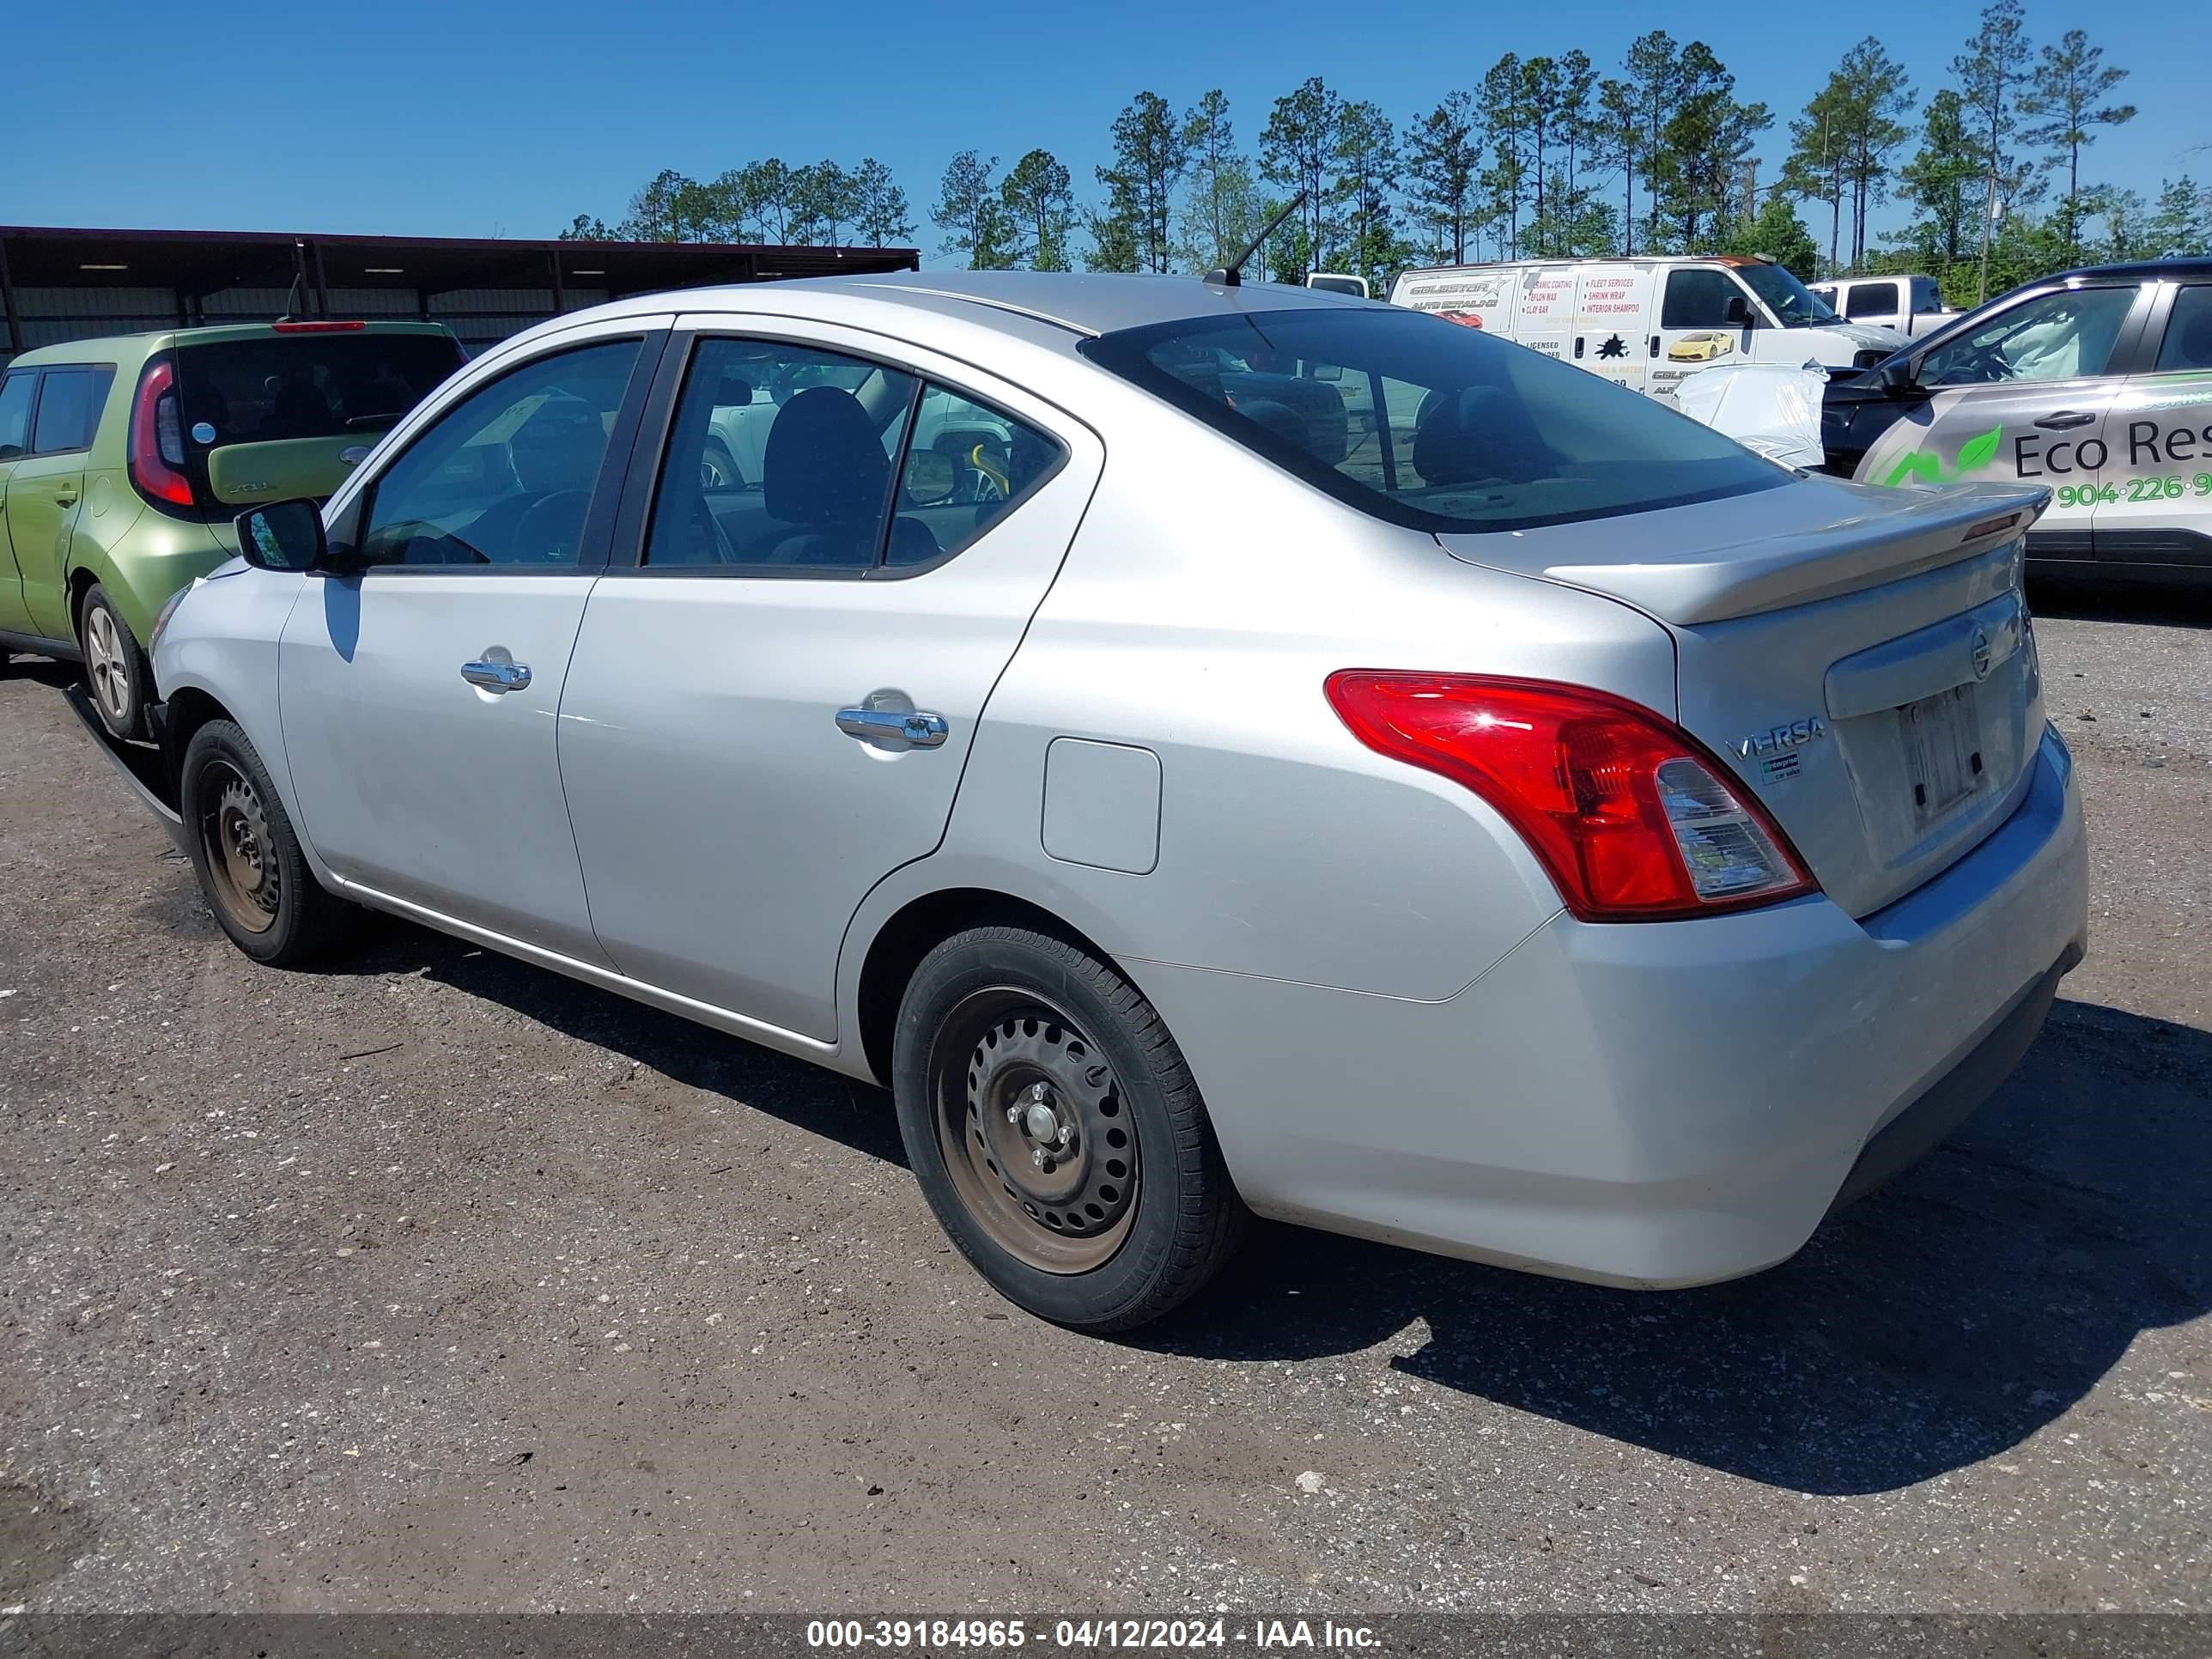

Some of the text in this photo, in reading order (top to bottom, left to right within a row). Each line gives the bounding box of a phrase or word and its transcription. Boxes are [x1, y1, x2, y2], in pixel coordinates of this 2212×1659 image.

[1532, 280, 1572, 289] ERAMIC COATING
[1589, 278, 1634, 289] FLEET SERVICES
[1410, 283, 1489, 295] GOLDSTAR
[1528, 293, 1558, 302] TEFLON WAX
[1588, 291, 1626, 301] SHRINK WRAP
[1411, 301, 1441, 310] AUTO
[1526, 305, 1549, 314] CLAY BAR
[1586, 303, 1640, 313] INTERIOR SHAMPOO
[2015, 434, 2108, 478] Eco
[1724, 716, 1826, 762] VERSA
[1764, 756, 1799, 772] enterprise
